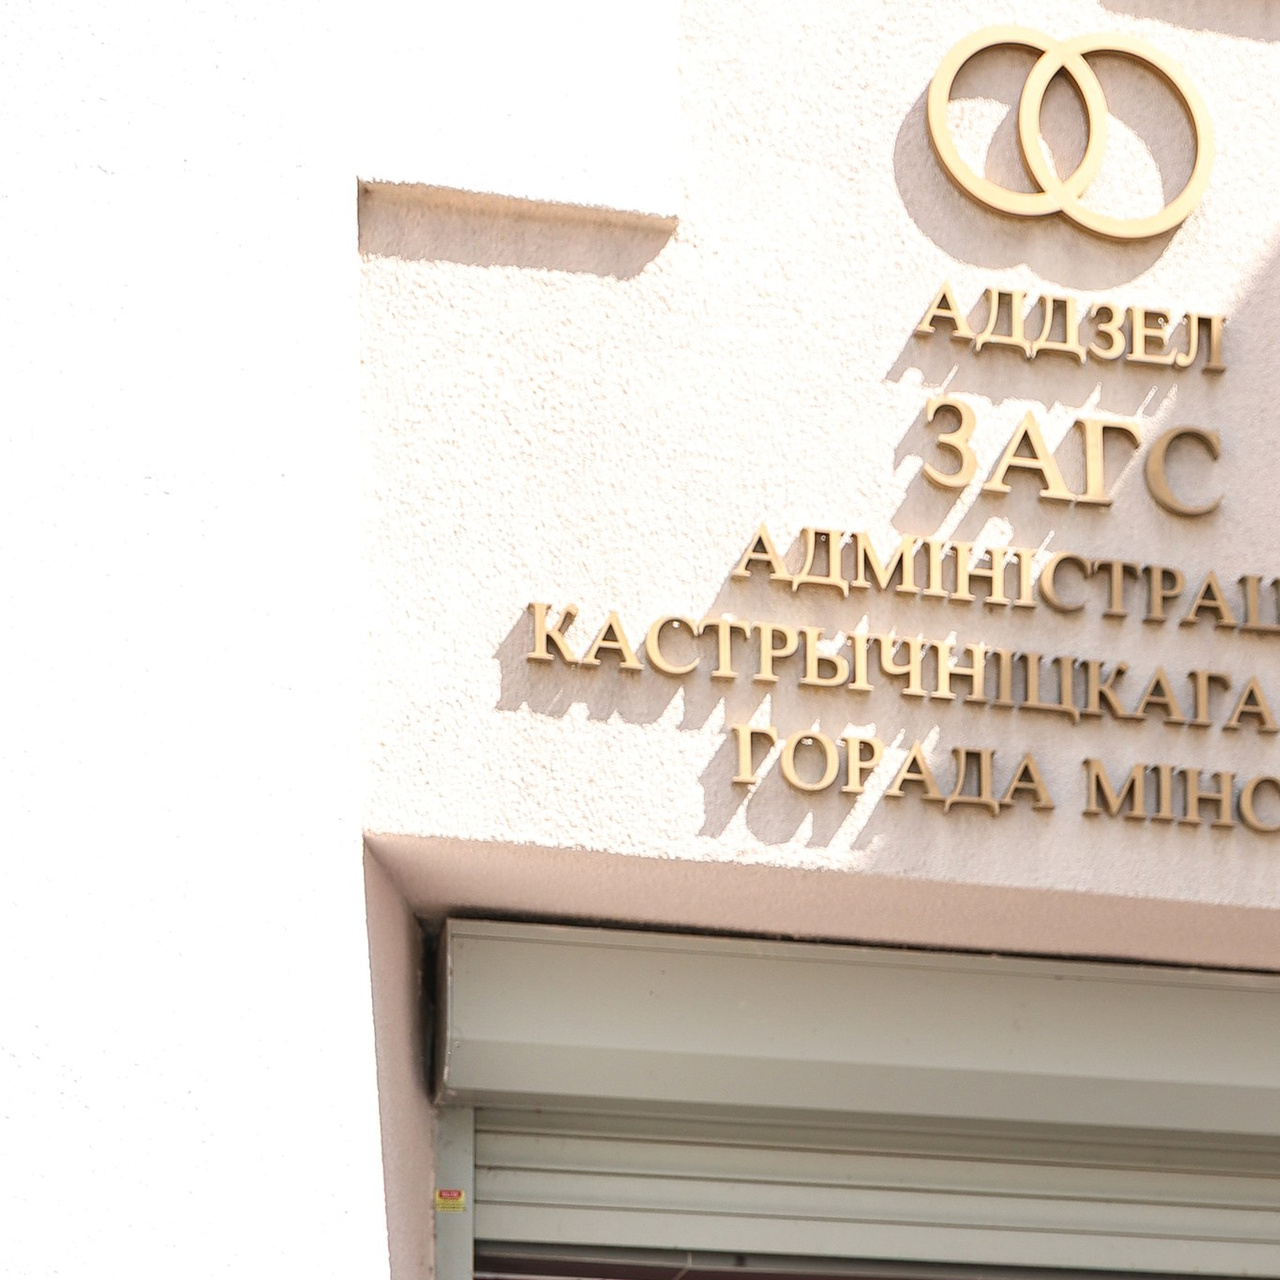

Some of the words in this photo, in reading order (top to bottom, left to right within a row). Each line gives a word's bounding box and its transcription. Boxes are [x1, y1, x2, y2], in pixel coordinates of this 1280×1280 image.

[914, 283, 1227, 373] АДДЗЕЛ
[922, 398, 1224, 517] ЗАГС
[528, 602, 1280, 736] КАСТРЫЧНІЦКАГА
[731, 725, 1055, 816] ГОРАДА
